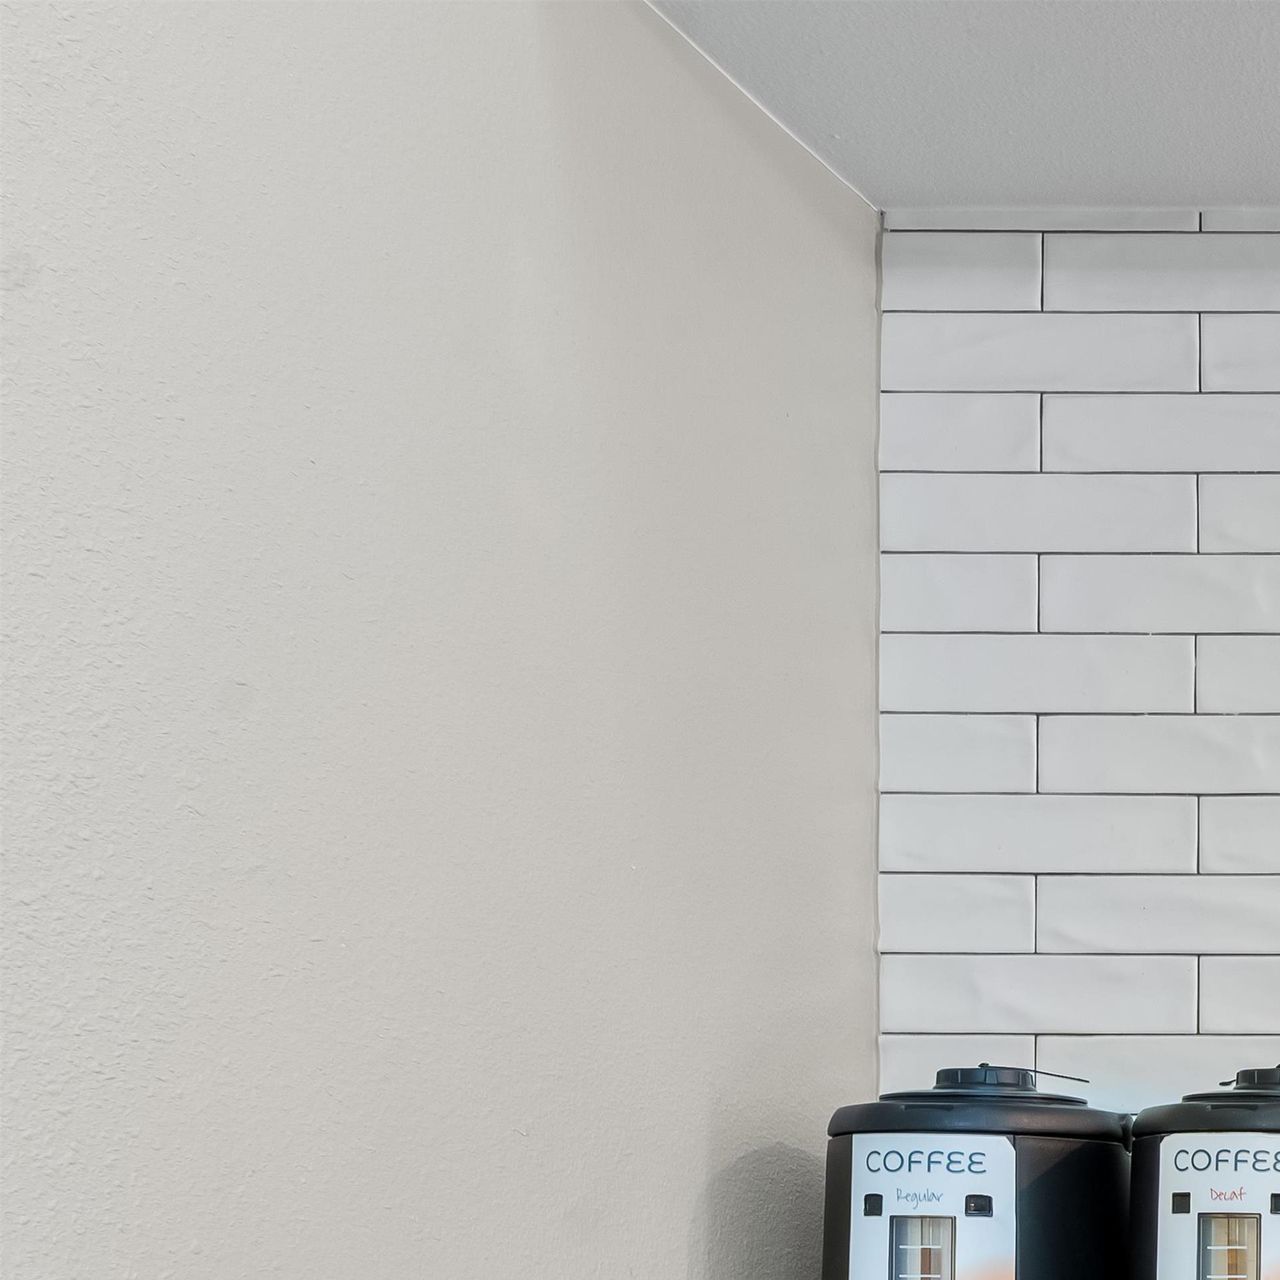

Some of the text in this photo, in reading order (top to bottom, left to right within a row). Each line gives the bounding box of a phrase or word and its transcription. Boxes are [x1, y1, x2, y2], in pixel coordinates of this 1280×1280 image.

[866, 1150, 987, 1174] COFFEE
[896, 1187, 944, 1210] Regular
[1210, 1186, 1246, 1201] Decaf
